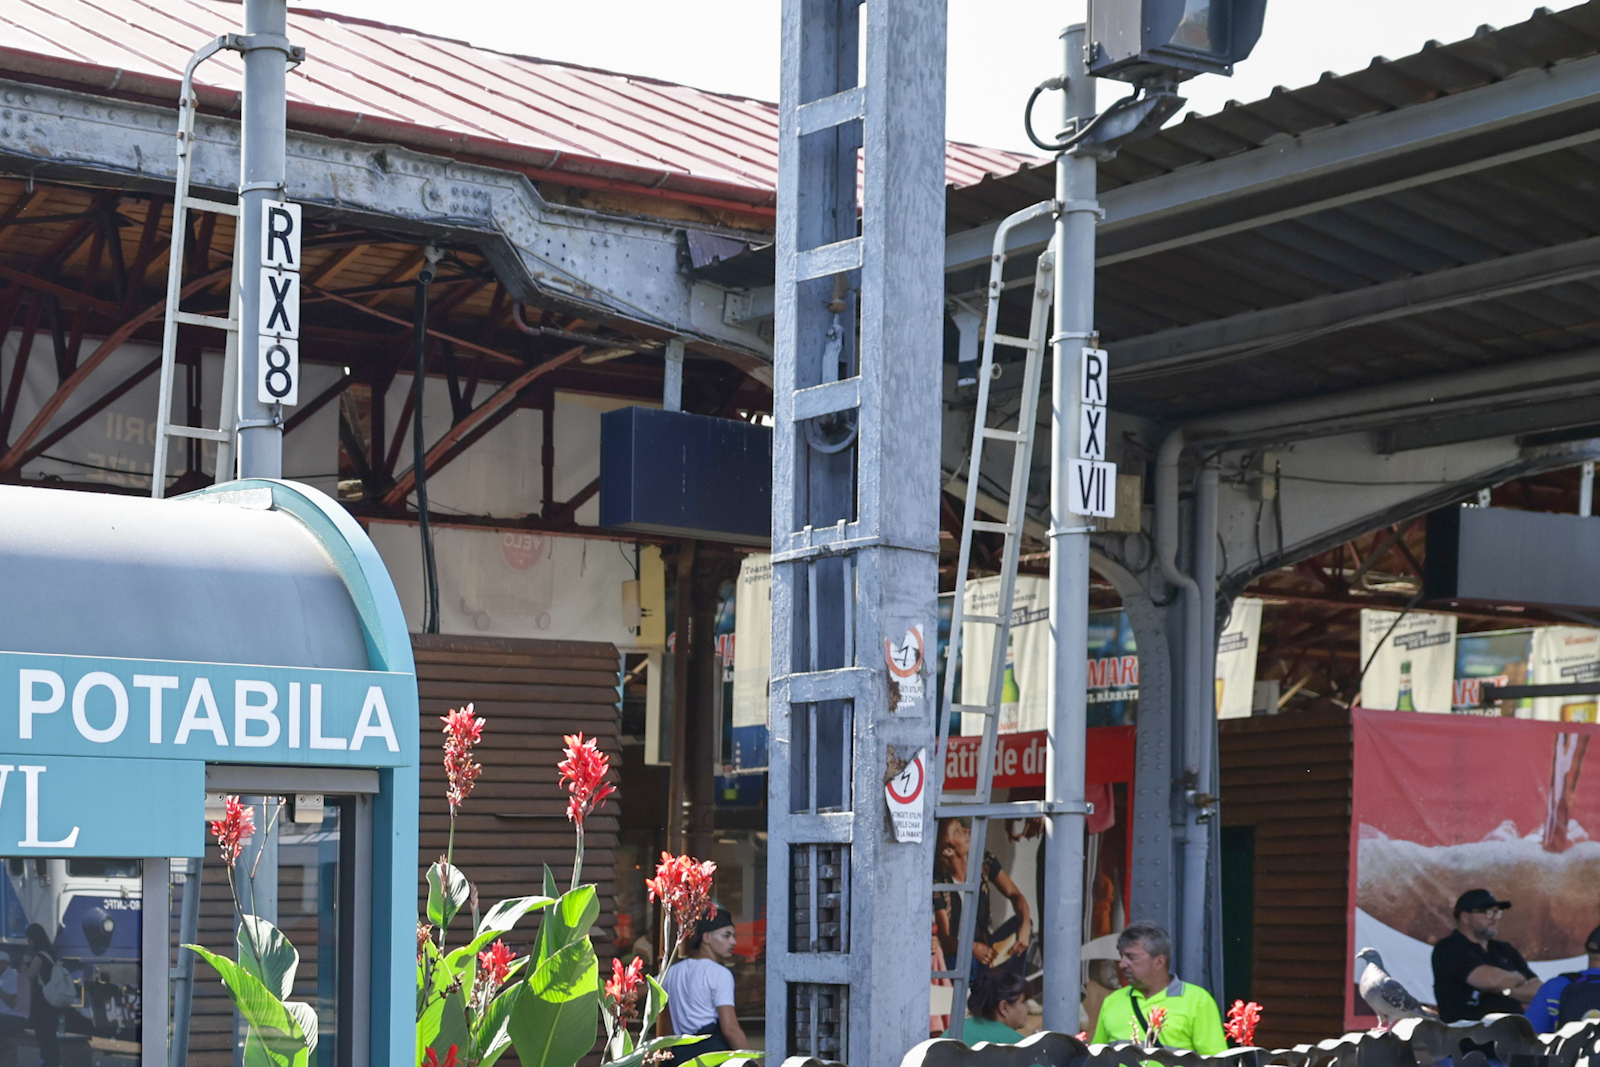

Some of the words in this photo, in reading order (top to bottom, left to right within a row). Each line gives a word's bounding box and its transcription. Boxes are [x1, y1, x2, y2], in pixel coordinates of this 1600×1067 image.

[267, 207, 293, 264] R
[266, 276, 292, 331] X
[265, 345, 292, 397] 8
[1086, 354, 1102, 400] R
[1085, 410, 1101, 454] X
[1078, 465, 1106, 511] VII
[17, 668, 401, 753] POTABILA
[1022, 738, 1046, 774] dr
